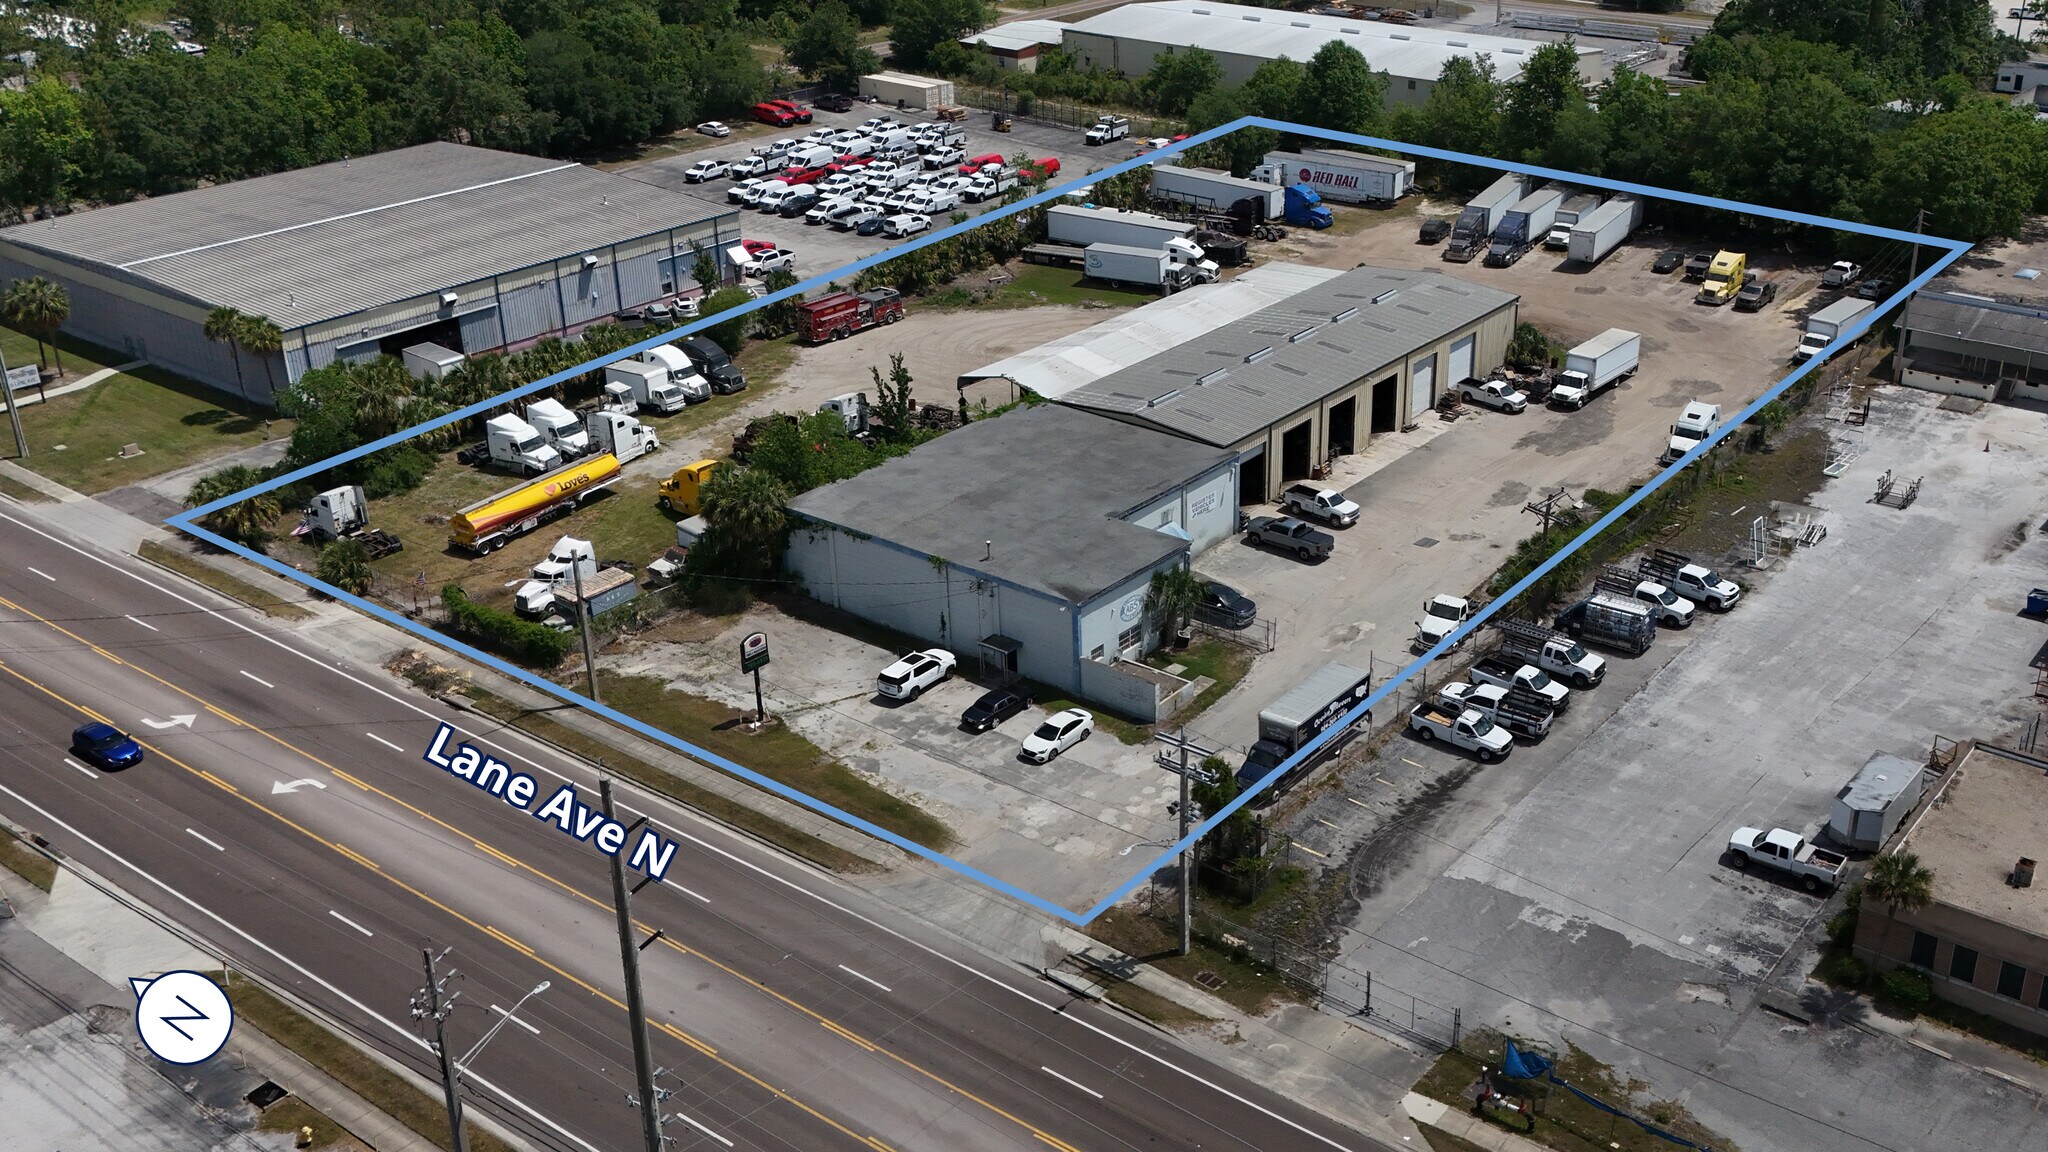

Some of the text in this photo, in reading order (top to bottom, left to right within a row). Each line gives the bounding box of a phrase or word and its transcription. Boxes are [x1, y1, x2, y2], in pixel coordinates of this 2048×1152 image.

[1312, 171, 1333, 185] RED
[1334, 174, 1359, 188] BALL
[1191, 492, 1215, 509] REGISTER
[1191, 498, 1215, 514] VEHICLES
[1197, 506, 1210, 516] HERE
